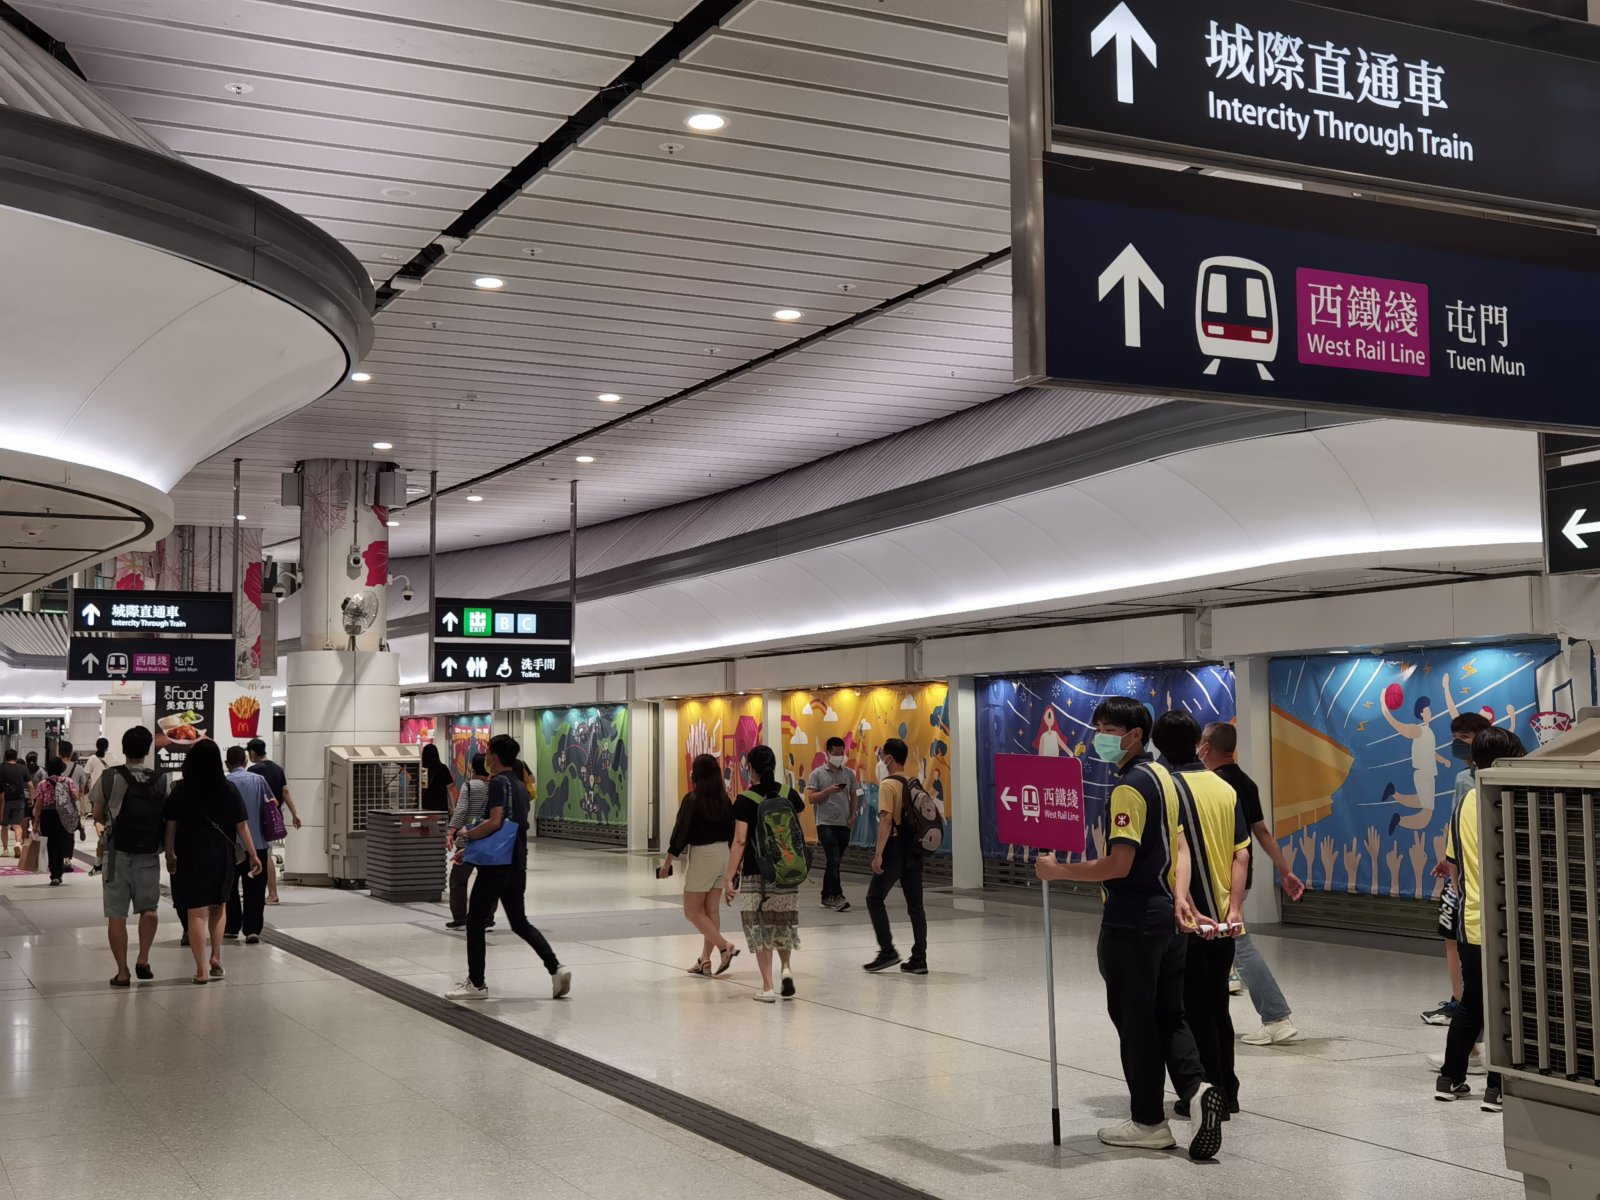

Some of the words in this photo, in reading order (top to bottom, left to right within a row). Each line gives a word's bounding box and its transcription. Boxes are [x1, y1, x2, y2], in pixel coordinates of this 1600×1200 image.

[1204, 19, 1450, 118] 城際直通車
[1208, 90, 1311, 141] Intercity
[1313, 108, 1414, 156] Through
[1417, 127, 1474, 162] Train
[1307, 283, 1419, 337] 西鐵綫
[1445, 299, 1509, 348] 屯門
[1307, 333, 1351, 358] West
[1355, 338, 1386, 361] Rail
[1391, 342, 1426, 366] Line
[1446, 349, 1487, 373] Tuen
[1490, 354, 1526, 377] Mun
[111, 604, 180, 619] 城際直通車
[469, 611, 487, 627] 出
[111, 619, 140, 628] Intercity
[141, 619, 169, 629] Through
[169, 620, 187, 628] Train
[500, 616, 510, 630] B
[522, 617, 532, 631] C
[521, 657, 556, 671] 洗手間
[1043, 787, 1079, 809] 西鐵綫
[1044, 810, 1057, 819] West
[1057, 810, 1067, 820] Rail
[1067, 811, 1079, 822] Line
